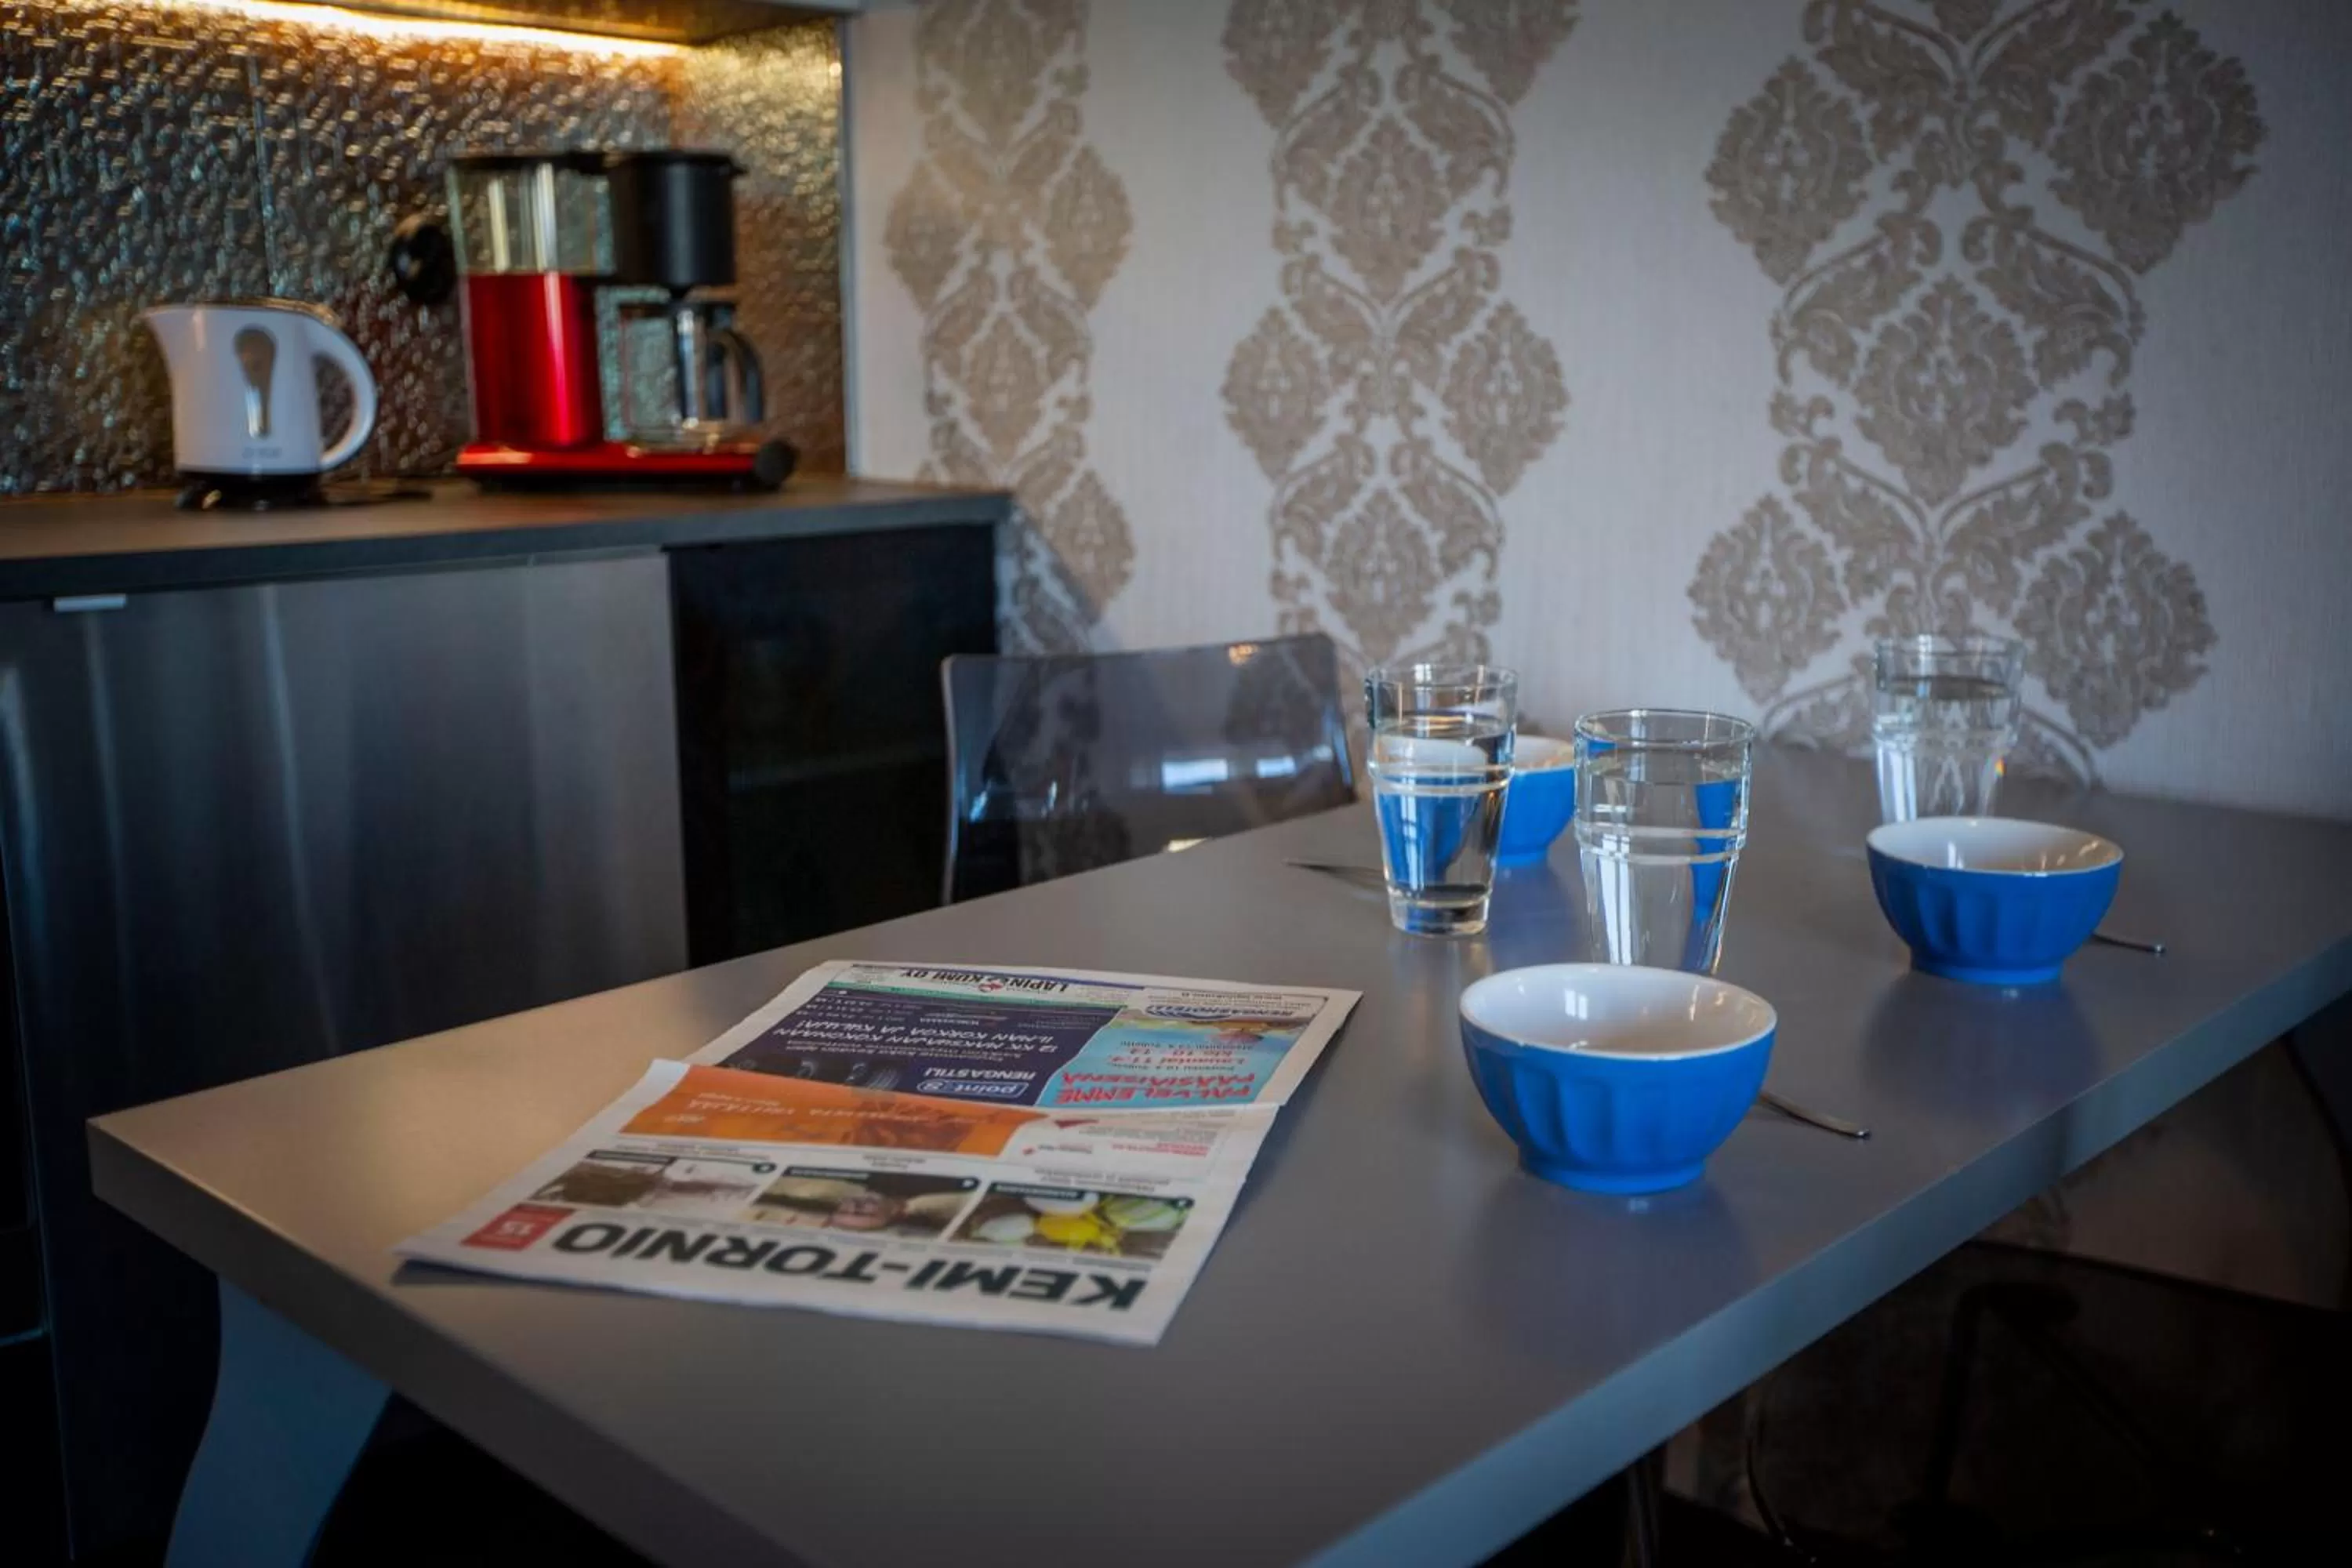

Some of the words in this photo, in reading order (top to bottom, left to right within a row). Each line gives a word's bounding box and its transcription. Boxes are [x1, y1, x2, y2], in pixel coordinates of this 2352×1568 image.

[932, 971, 986, 983] KUMI
[1007, 978, 1069, 993] LAPIN
[772, 1027, 882, 1044] KOKONAAN
[912, 1026, 987, 1040] KORKOA
[885, 1035, 997, 1050] MAKSUAJAN
[924, 1067, 1037, 1080] RENGASTILI
[953, 1082, 1018, 1094] point
[552, 1221, 1146, 1311] KEMI-TORNIO
